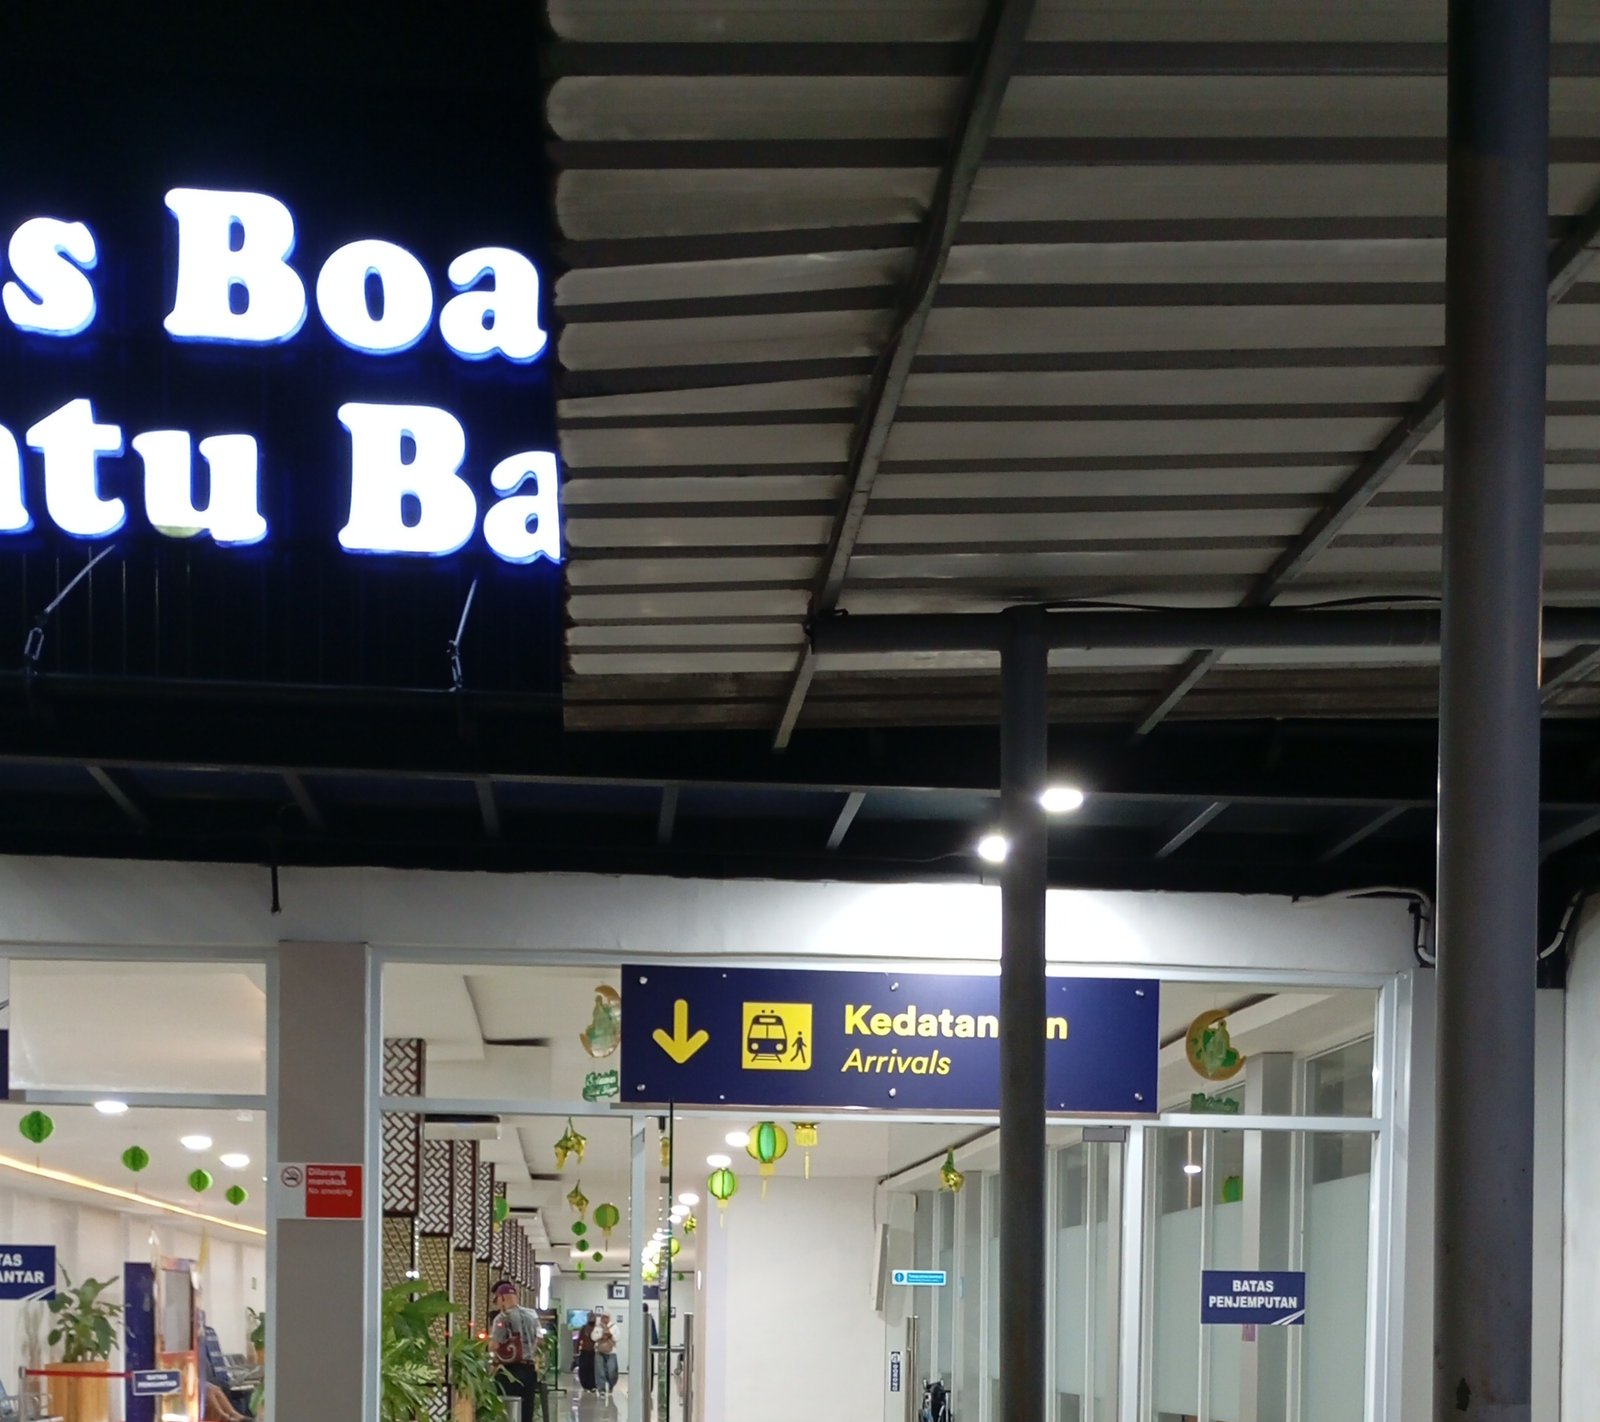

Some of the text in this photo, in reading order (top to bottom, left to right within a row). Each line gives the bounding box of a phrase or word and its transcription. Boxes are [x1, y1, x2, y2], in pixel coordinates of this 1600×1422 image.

[164, 187, 548, 364] Boa
[337, 402, 562, 565] Ba
[844, 1004, 1069, 1040] Kedatann
[841, 1048, 951, 1076] Arrivals
[307, 1167, 347, 1180] Dilarang
[1232, 1279, 1275, 1293] BATAS
[1208, 1295, 1298, 1309] PENJEMPUTAN
